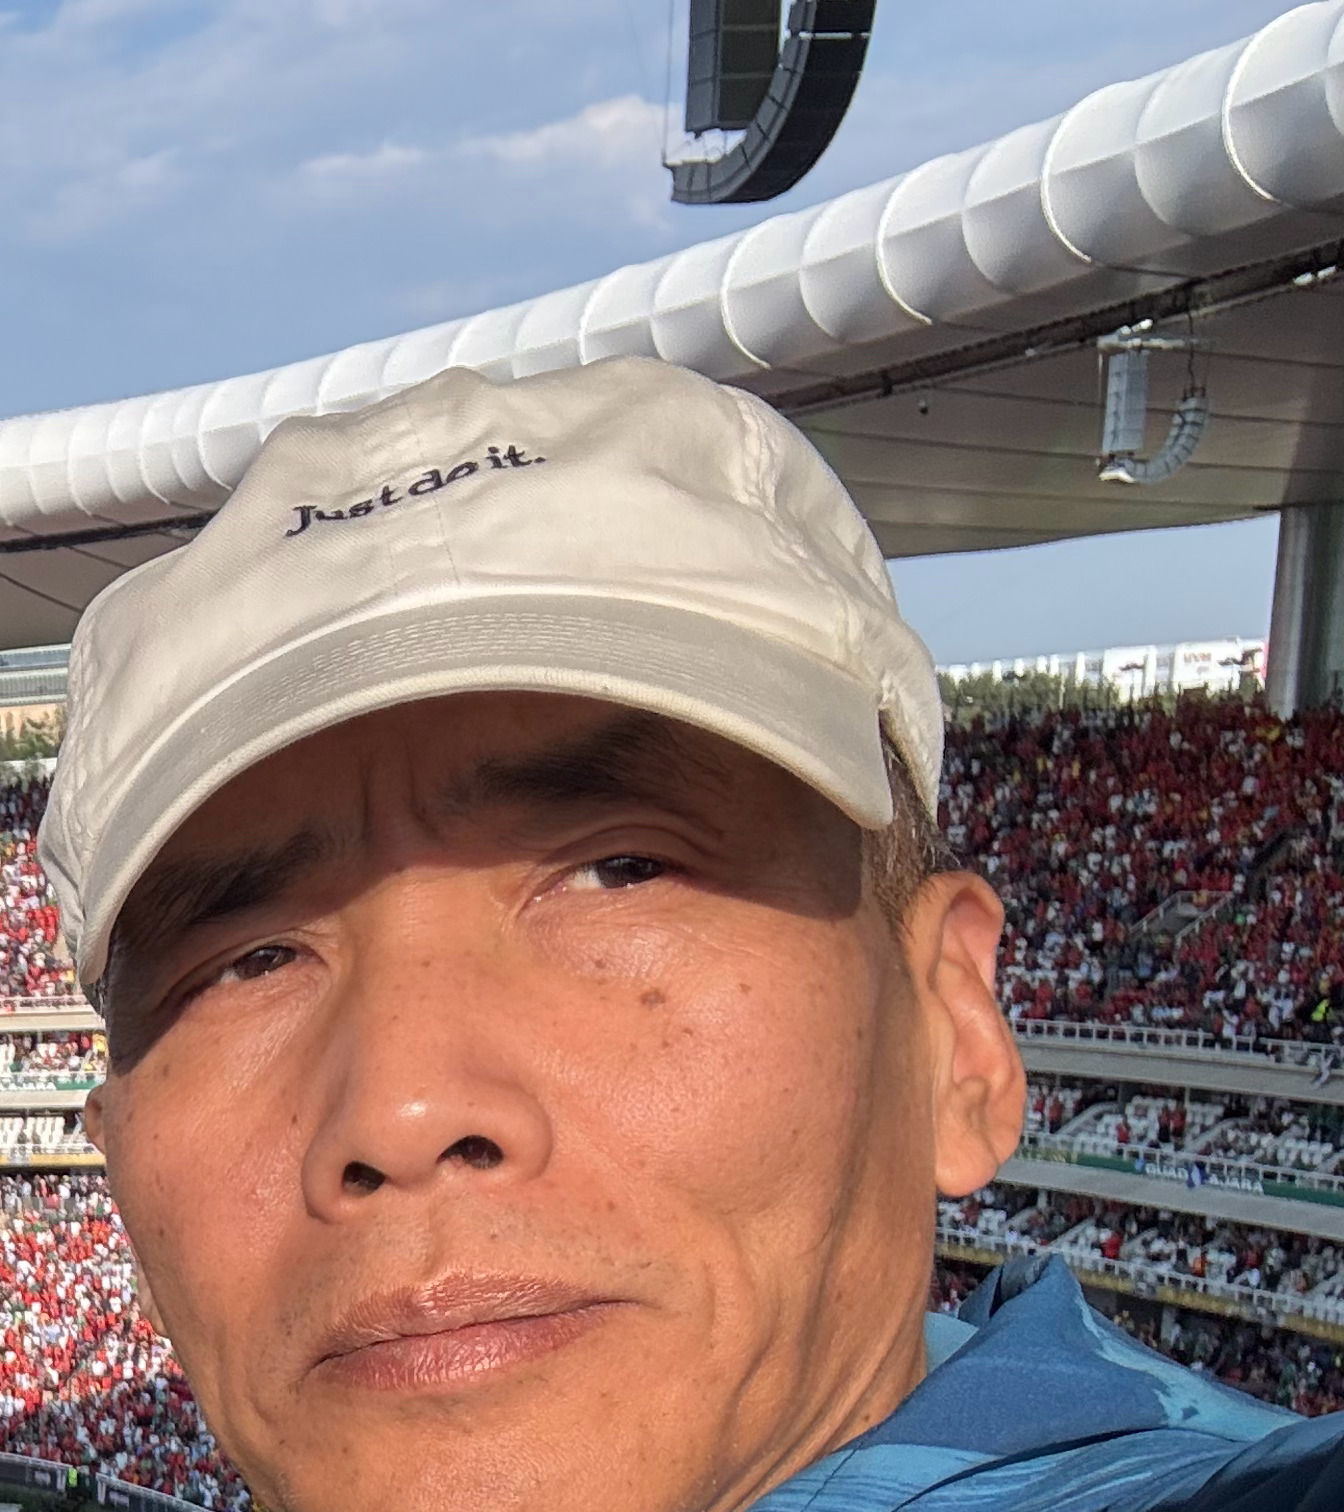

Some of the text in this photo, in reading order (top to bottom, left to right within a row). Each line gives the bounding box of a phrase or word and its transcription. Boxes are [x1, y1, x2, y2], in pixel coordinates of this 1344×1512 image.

[284, 444, 548, 538] Just do it.
